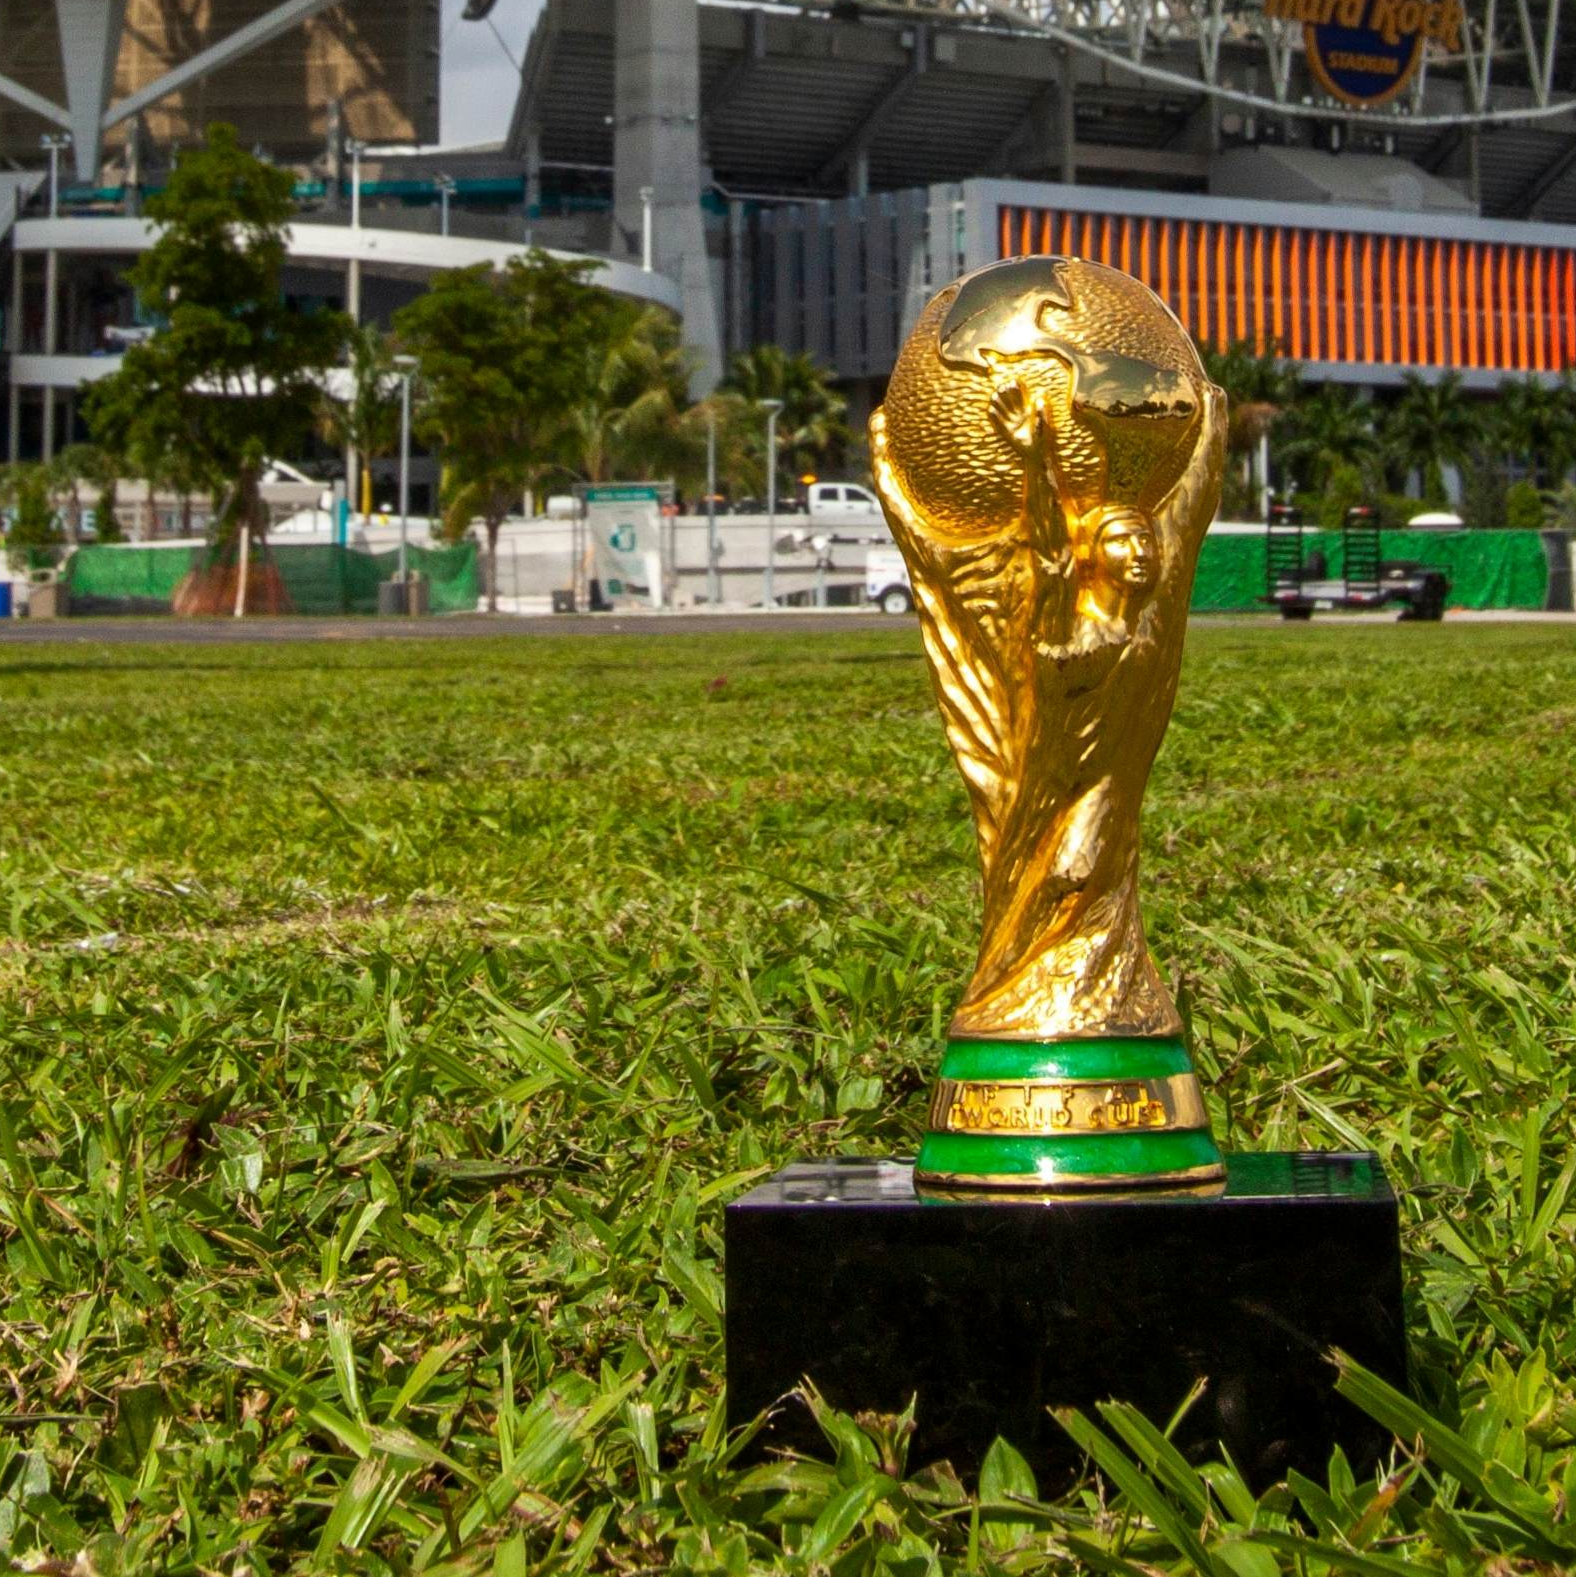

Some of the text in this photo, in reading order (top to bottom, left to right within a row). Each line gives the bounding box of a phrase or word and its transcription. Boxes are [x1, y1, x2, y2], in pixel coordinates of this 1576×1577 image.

[983, 1083, 1128, 1107] FIFA
[964, 1102, 1158, 1128] WORLD CUP
